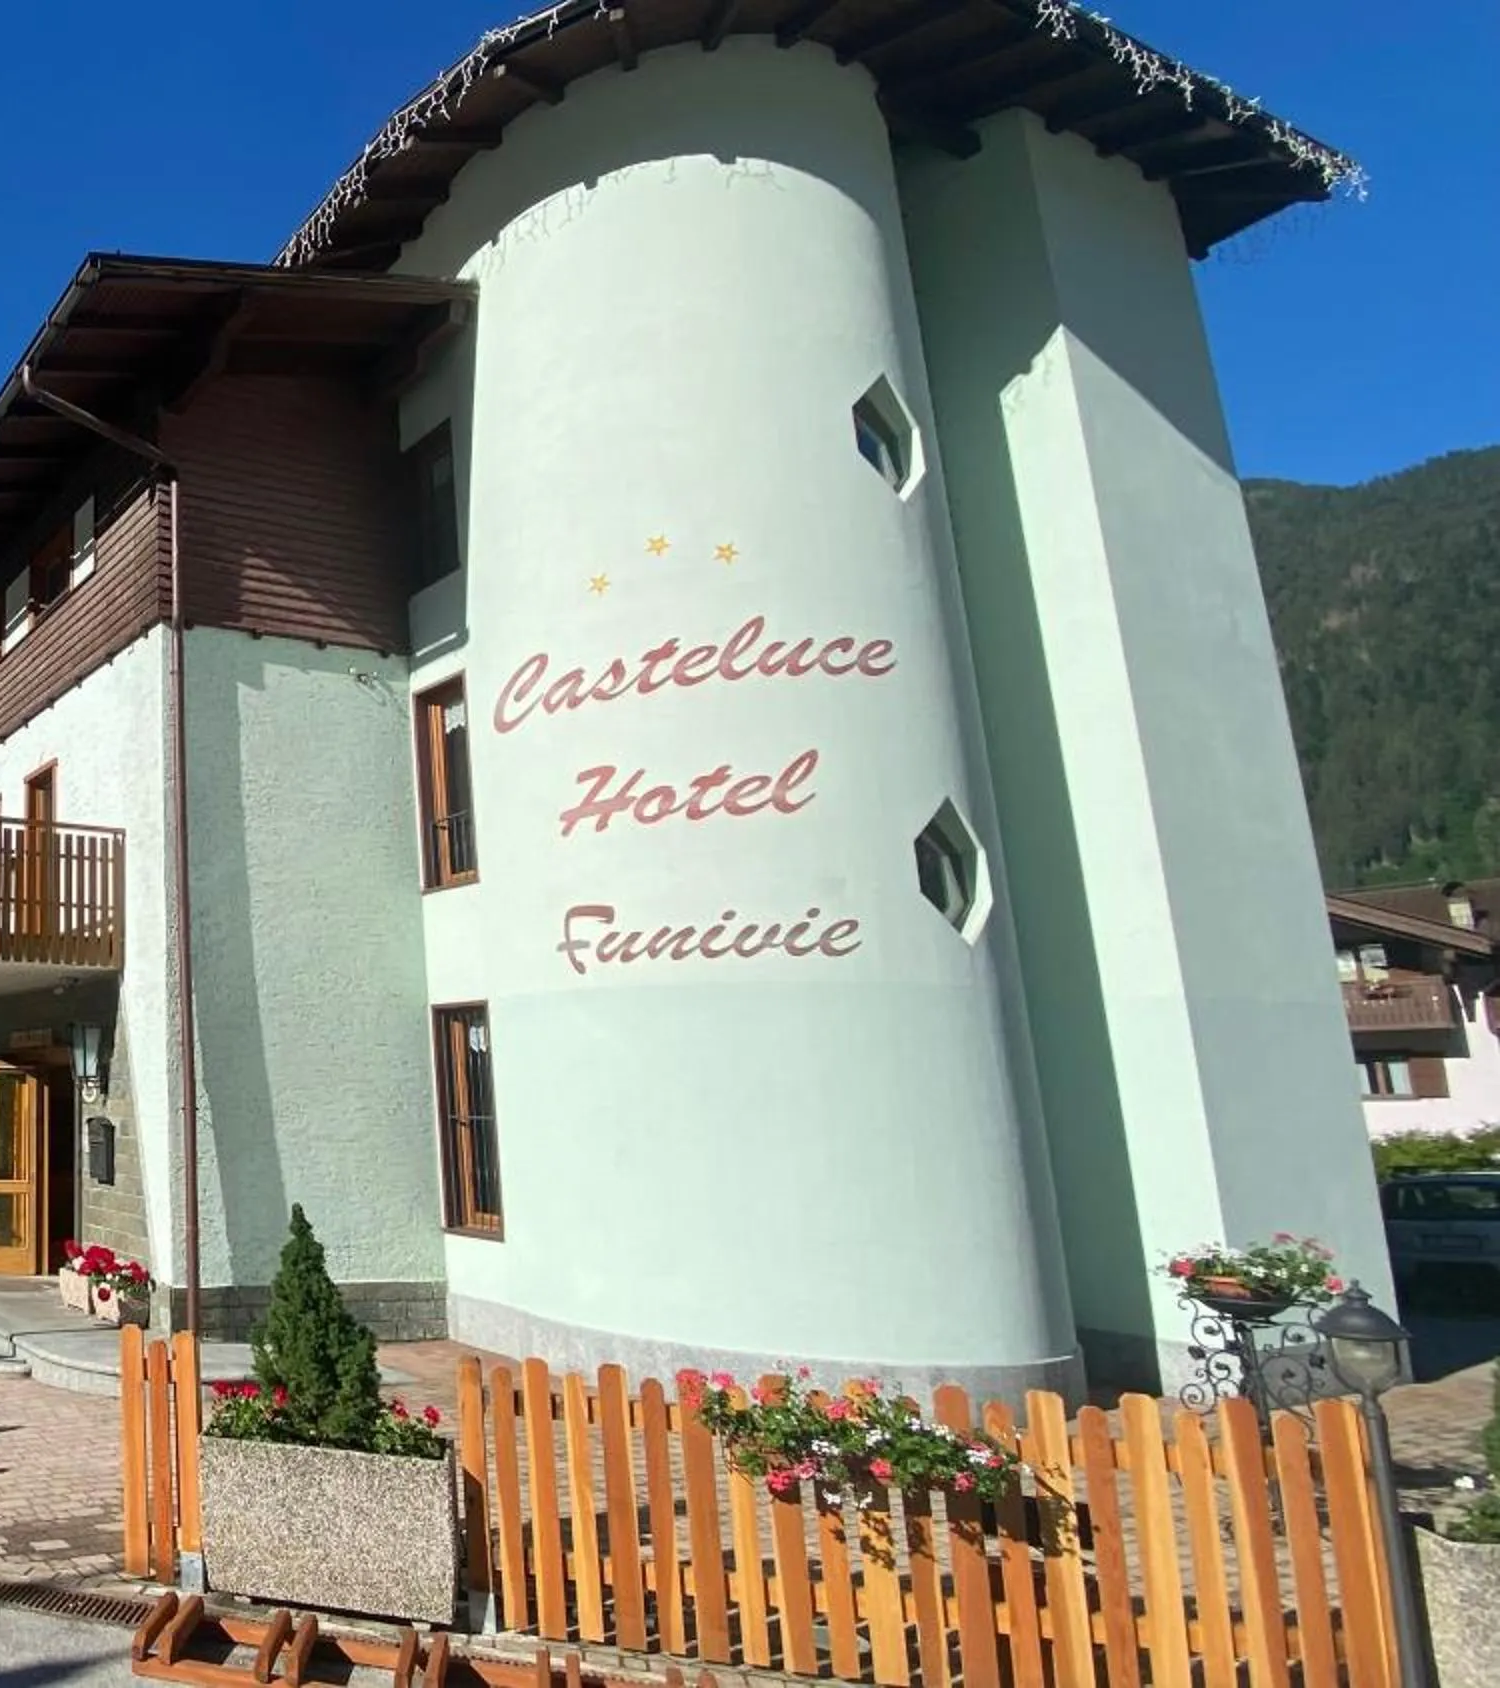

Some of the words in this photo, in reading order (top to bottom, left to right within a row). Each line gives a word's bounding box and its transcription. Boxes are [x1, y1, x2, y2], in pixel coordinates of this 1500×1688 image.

[493, 615, 898, 734] Casteluce
[559, 748, 820, 837] Hotel
[556, 905, 863, 975] Funivie
